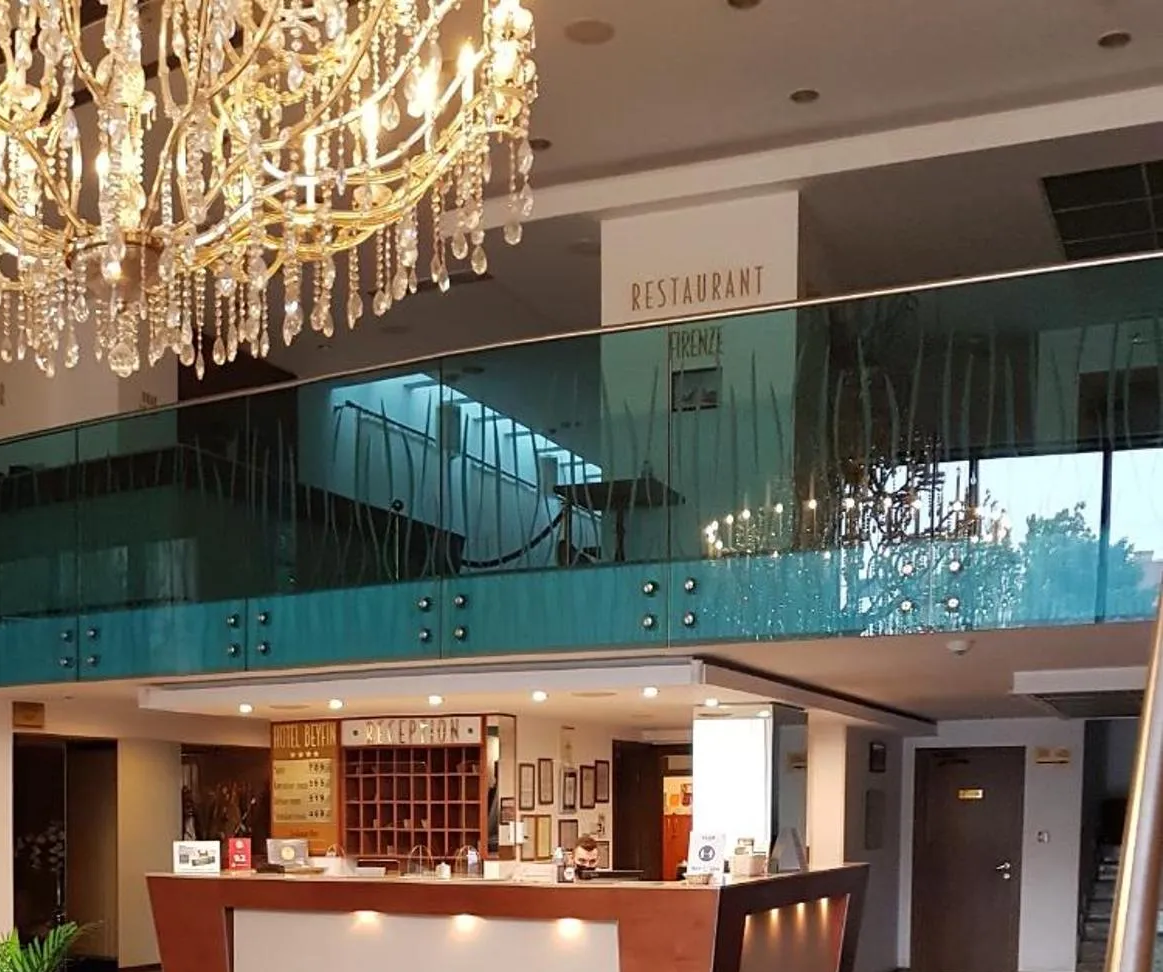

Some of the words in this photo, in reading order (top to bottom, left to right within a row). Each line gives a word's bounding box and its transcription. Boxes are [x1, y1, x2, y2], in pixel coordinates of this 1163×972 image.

[631, 265, 765, 312] RESTAURANT
[667, 325, 724, 359] FIRENZE
[273, 726, 300, 749] HOTEL
[365, 718, 460, 745] RECEPTION
